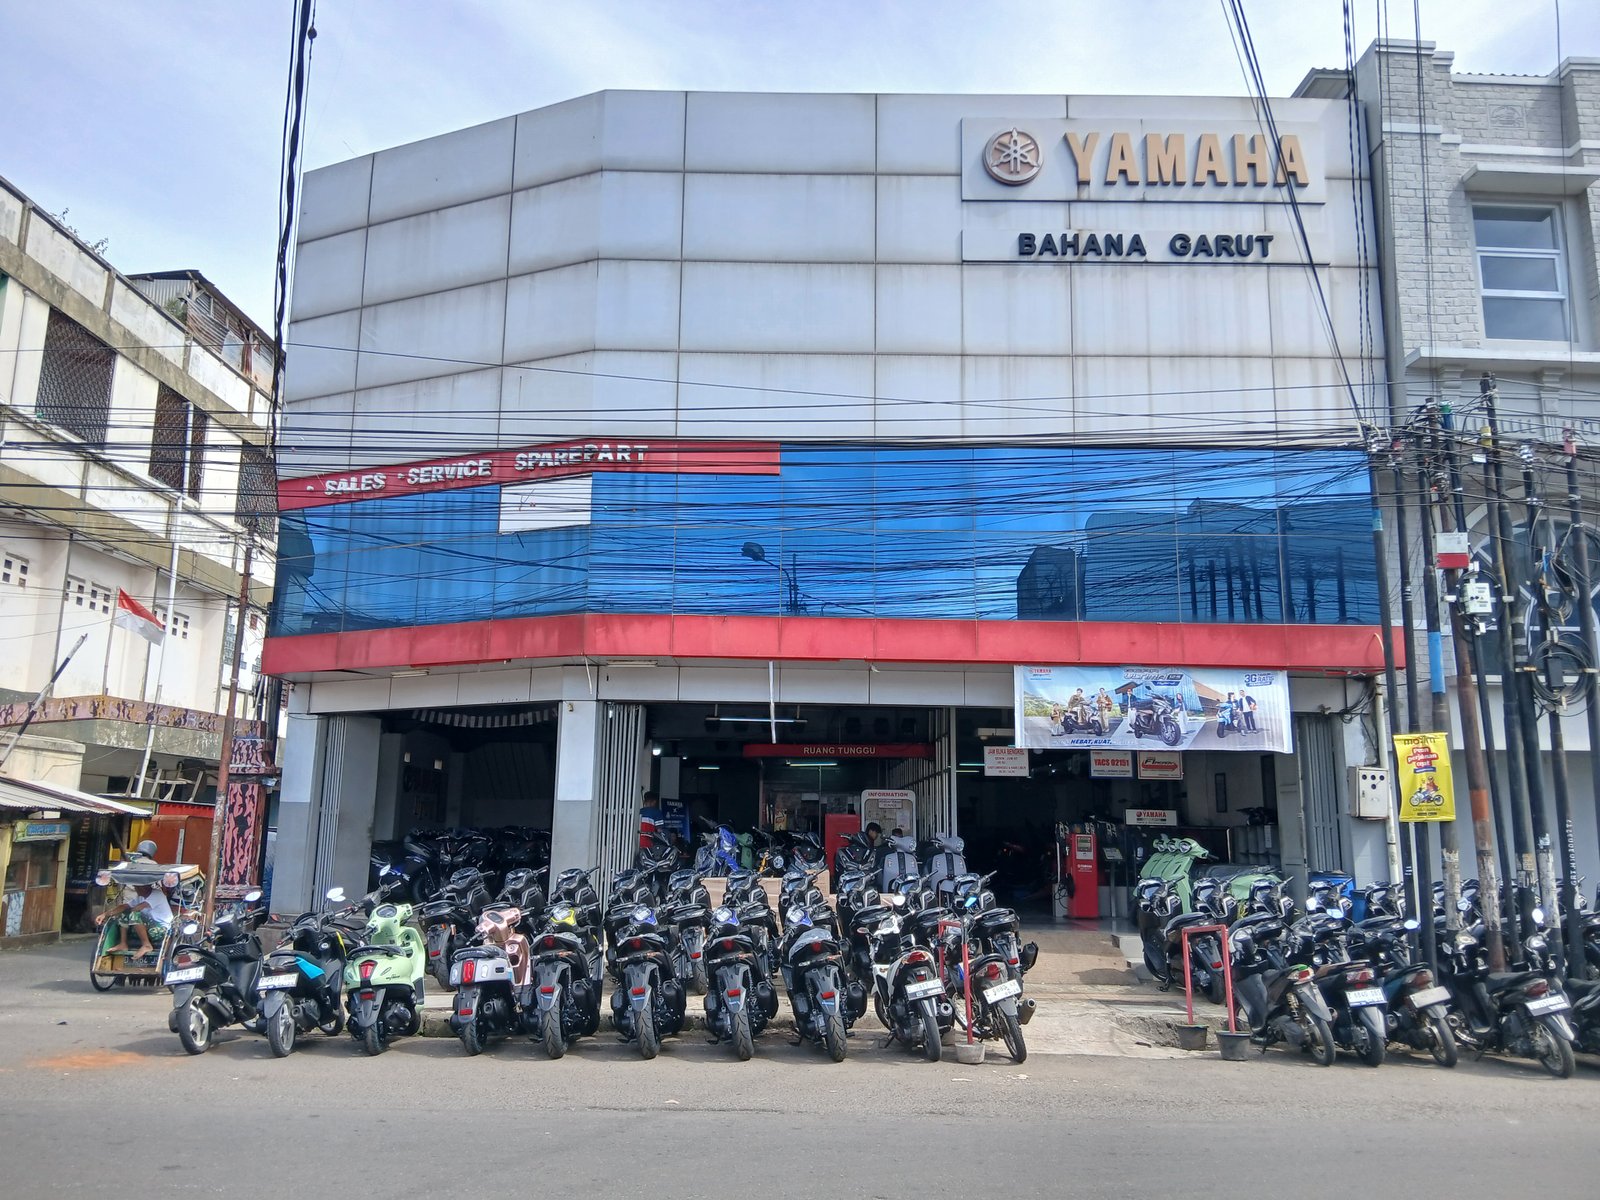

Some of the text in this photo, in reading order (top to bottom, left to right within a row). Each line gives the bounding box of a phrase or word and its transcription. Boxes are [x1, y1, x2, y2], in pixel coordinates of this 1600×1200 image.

[1063, 132, 1310, 188] YAMAHA
[1018, 233, 1274, 258] BAHANA GARUT
[324, 445, 649, 496] SALES SERVICE SPAREPART
[803, 746, 876, 755] RUANG TUNGGU
